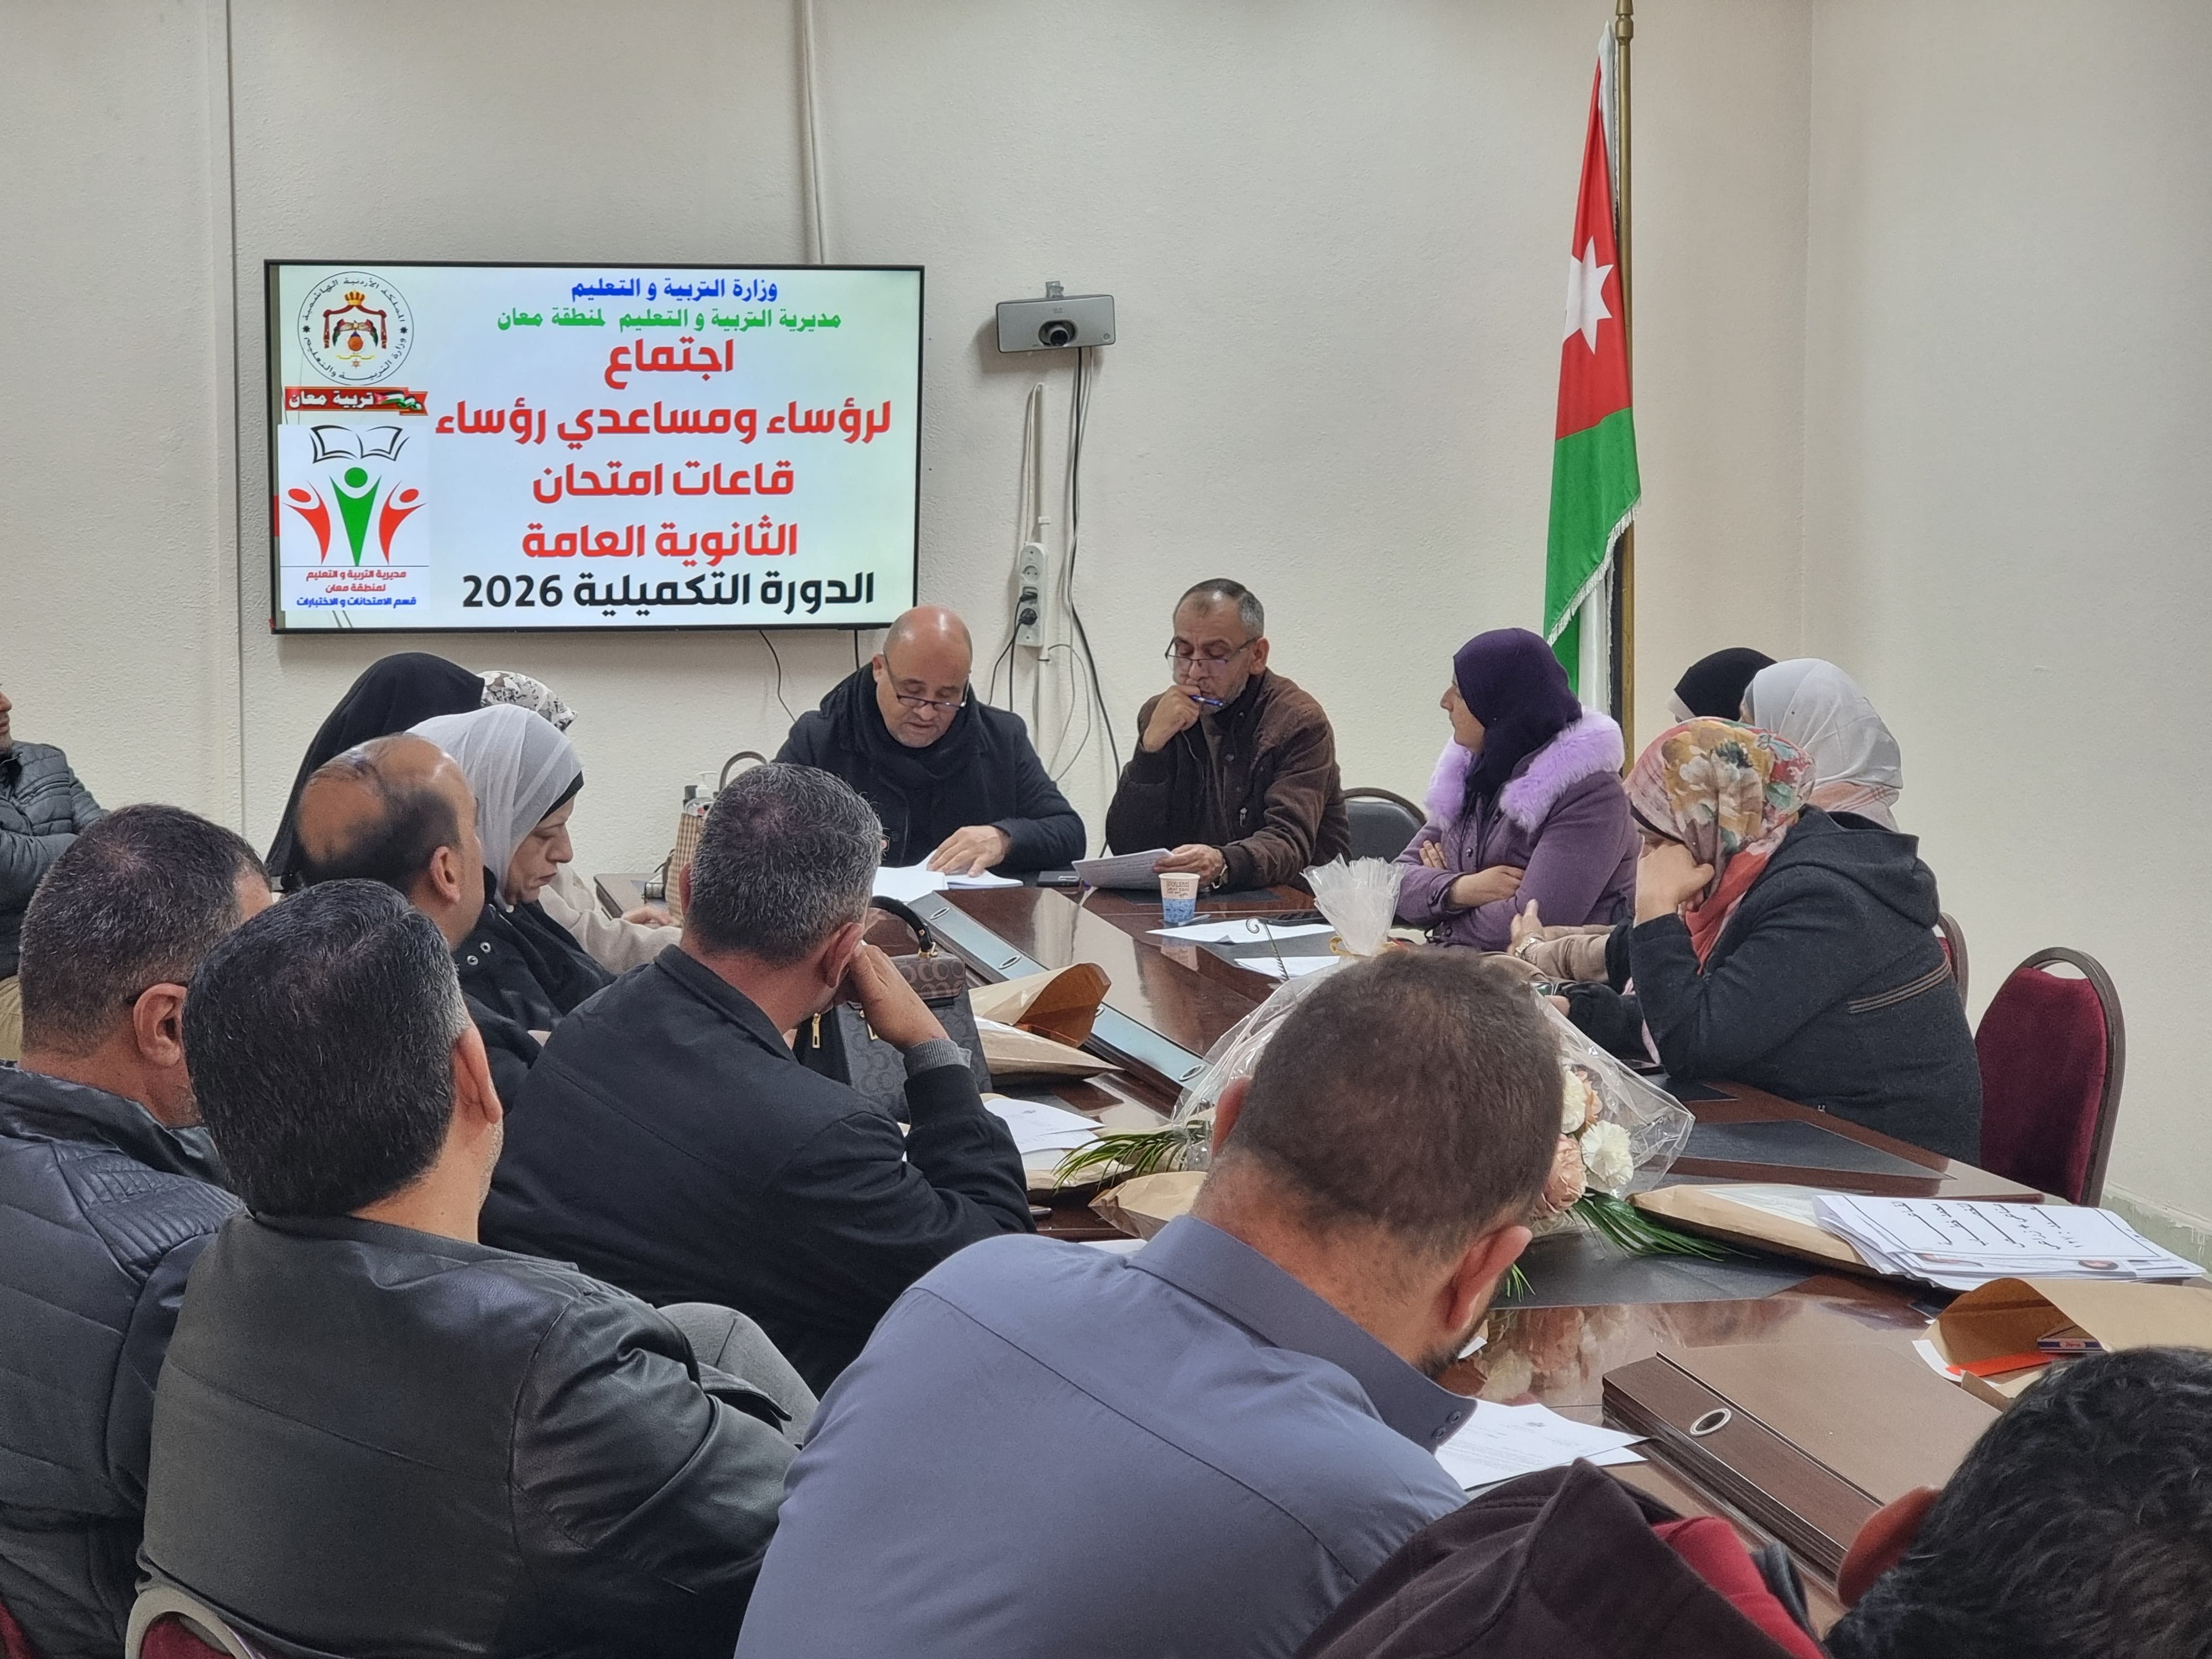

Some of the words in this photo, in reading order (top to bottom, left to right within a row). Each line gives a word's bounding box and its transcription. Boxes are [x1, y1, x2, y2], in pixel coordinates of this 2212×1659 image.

[571, 277, 641, 302] التعليم
[645, 282, 658, 302] و
[663, 278, 726, 302] التربية
[732, 278, 779, 302] وزارة
[497, 307, 544, 331] معان
[551, 307, 606, 327] لمنطقة
[619, 309, 688, 331] التعليم
[695, 312, 705, 332] و
[711, 309, 773, 332] التربية
[779, 309, 842, 332] مديرية
[604, 336, 734, 389] اجتماع
[288, 389, 328, 409] معان
[332, 389, 375, 409] تربية
[435, 397, 546, 445] رؤساء
[557, 401, 757, 450] ومساعدي
[766, 397, 891, 444] لرؤساء
[533, 461, 663, 504] امتحان
[672, 460, 794, 496] قاعات
[522, 523, 646, 558] العامة
[655, 514, 797, 567] الثانوية
[306, 570, 338, 581] التعليم
[340, 572, 346, 580] و
[347, 570, 374, 580] التربية
[376, 570, 406, 580] مديرية
[325, 583, 349, 593] معان
[351, 583, 386, 592] لمنطقة
[463, 574, 563, 608] 2026
[573, 571, 750, 617] التكميلية
[760, 570, 874, 615] الدورة
[347, 597, 392, 606] الامتحانات
[393, 597, 416, 608] قسم
